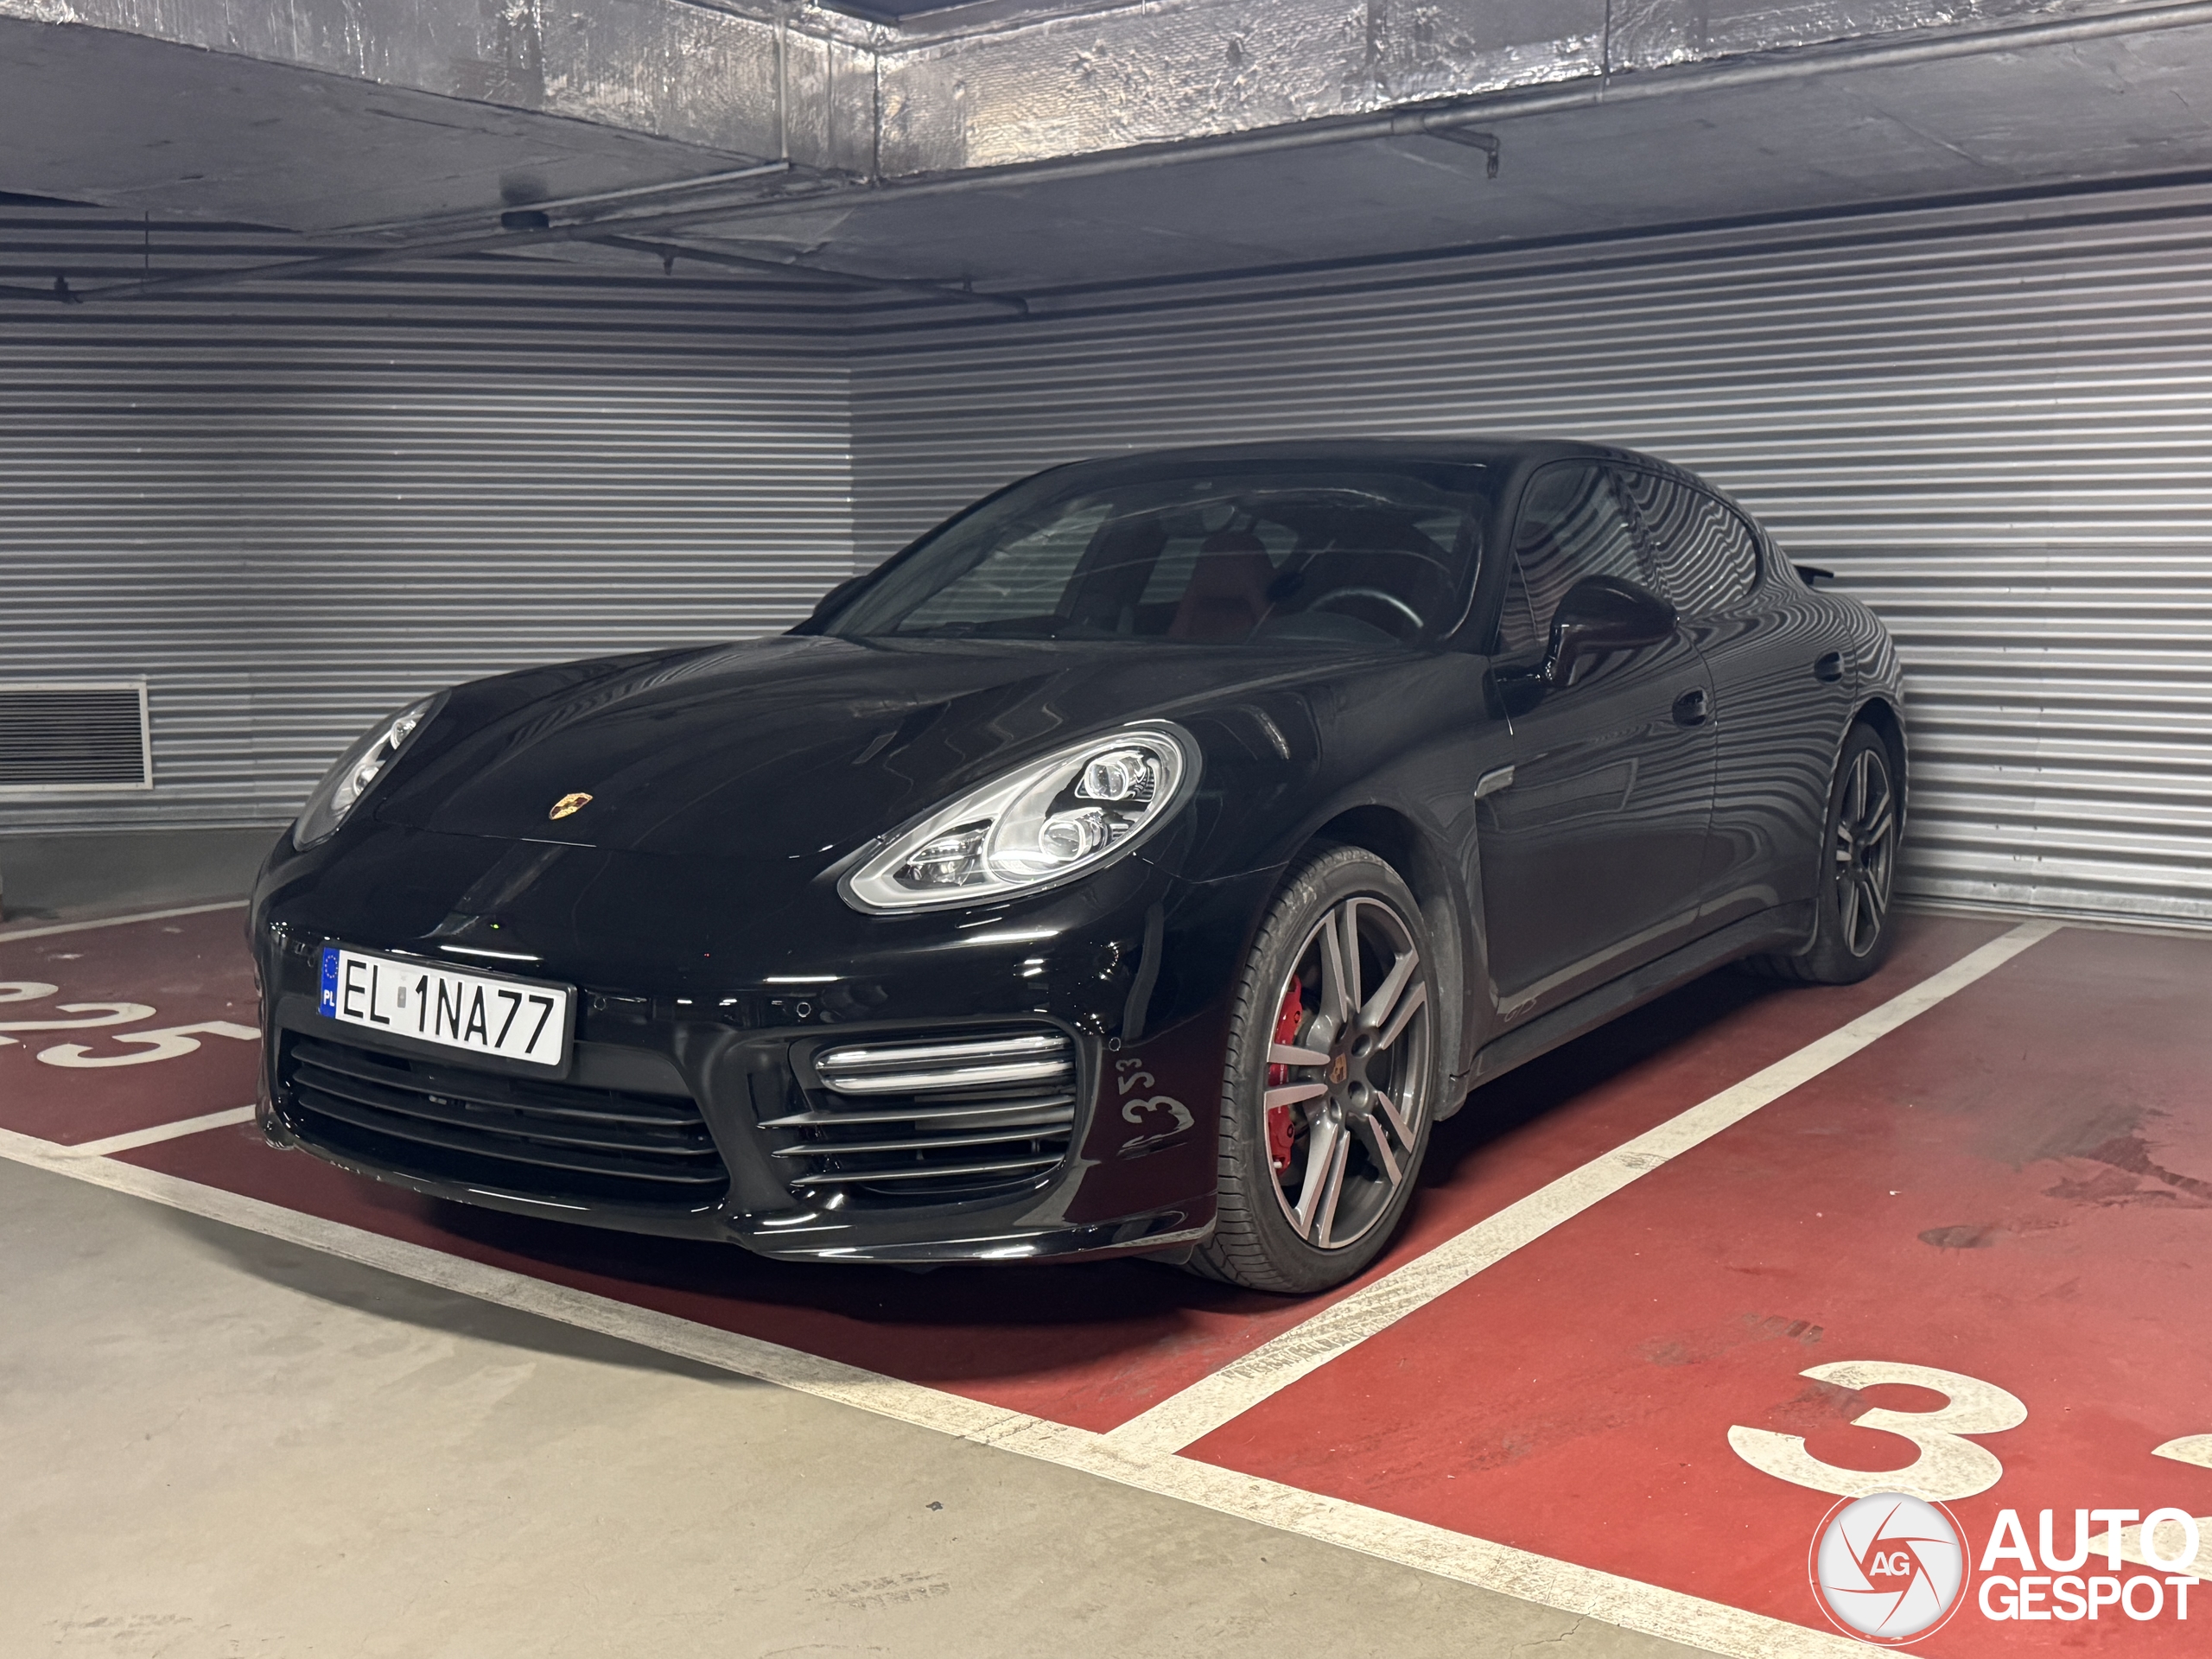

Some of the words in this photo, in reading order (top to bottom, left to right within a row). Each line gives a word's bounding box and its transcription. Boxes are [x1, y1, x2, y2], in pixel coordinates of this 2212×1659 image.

[323, 989, 335, 1007] PL
[344, 959, 391, 1025] EL
[415, 975, 555, 1054] 1NA77
